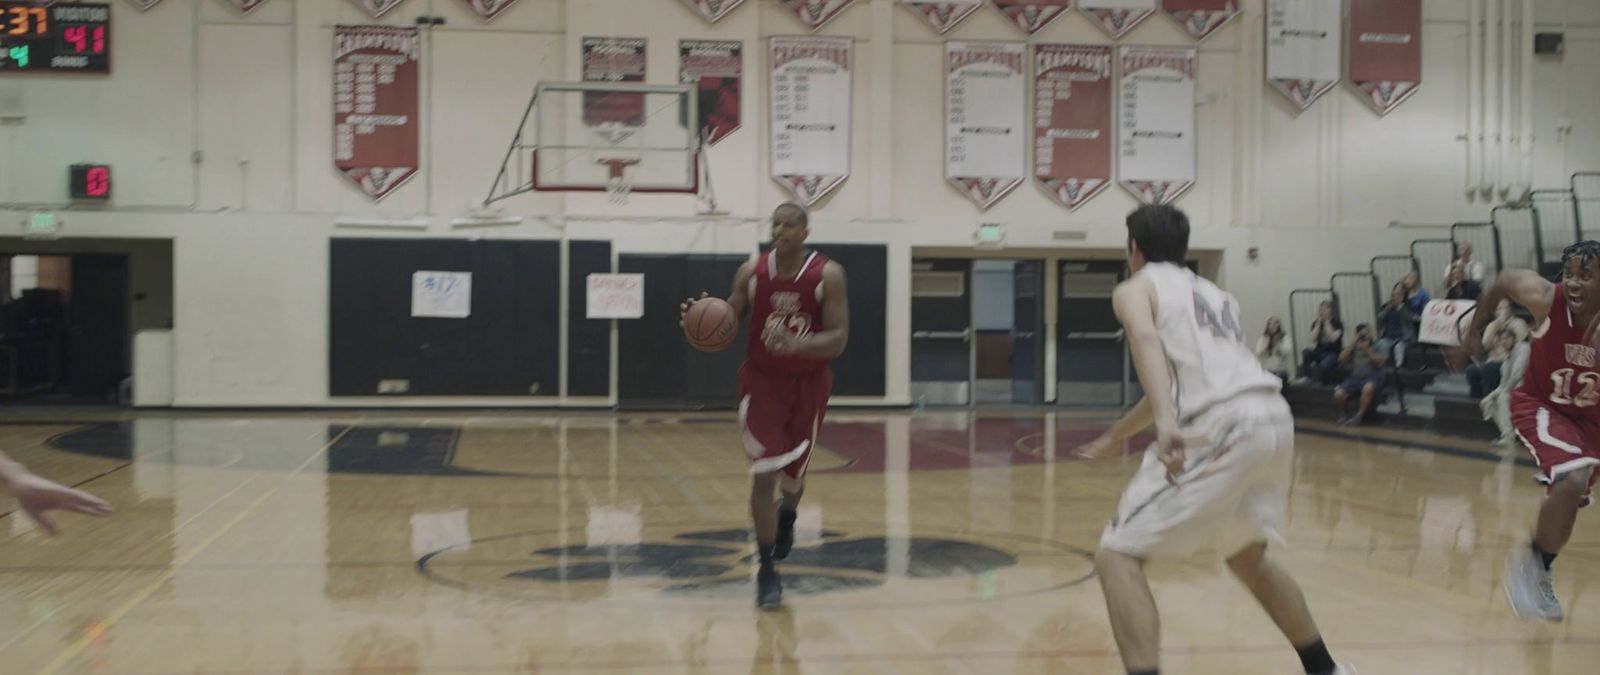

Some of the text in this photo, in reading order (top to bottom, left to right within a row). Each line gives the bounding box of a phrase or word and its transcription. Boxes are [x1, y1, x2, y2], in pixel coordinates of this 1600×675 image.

[64, 25, 105, 53] 41
[335, 33, 419, 61] CHAMPIONS
[9, 45, 29, 67] 4
[773, 46, 848, 71] CHAMPIONS
[949, 51, 1023, 75] CHAMPIONS
[1036, 52, 1111, 79] CHAMPIONS
[1430, 302, 1456, 317] GO
[1549, 367, 1600, 407] 12
